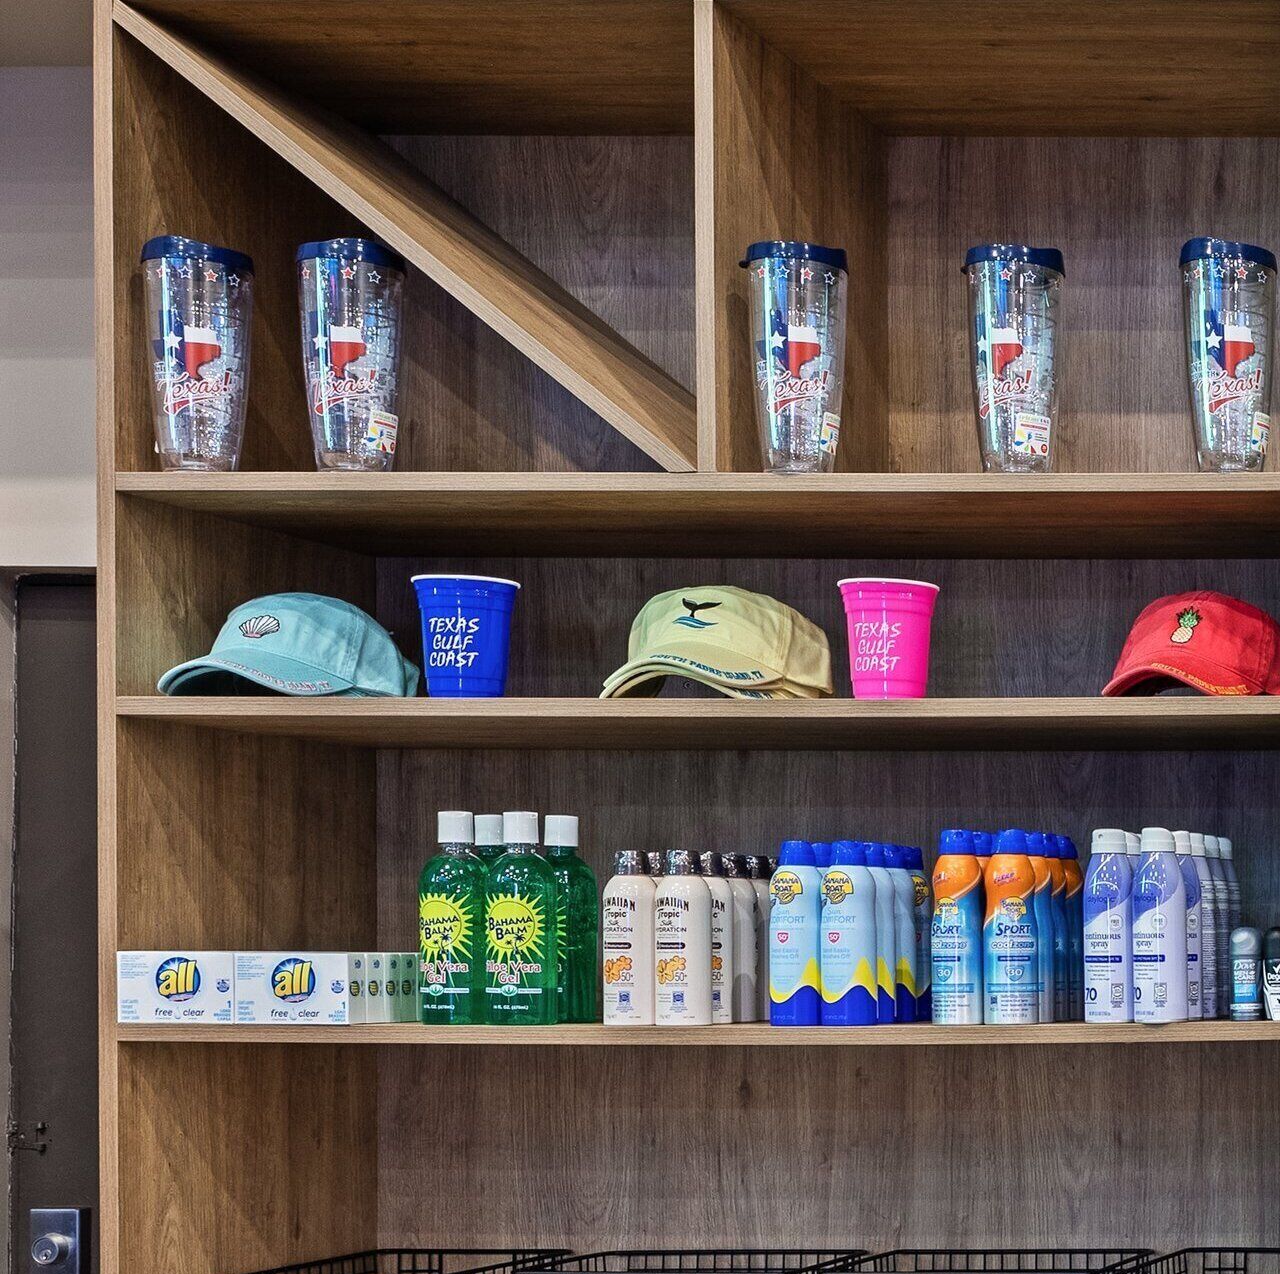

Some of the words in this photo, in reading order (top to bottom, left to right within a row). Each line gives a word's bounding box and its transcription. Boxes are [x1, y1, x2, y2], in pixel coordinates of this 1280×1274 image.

[157, 370, 232, 416] Texas!
[428, 616, 481, 634] TEXAS
[854, 621, 902, 637] TEXAS
[432, 634, 474, 650] GULF
[857, 639, 896, 655] GULF
[429, 651, 480, 668] COAST
[854, 655, 902, 672] COAST
[771, 874, 798, 885] BANANA
[823, 873, 850, 885] BANANA
[773, 884, 793, 893] BOAT
[824, 884, 844, 893] BOAT
[605, 908, 628, 918] Tropic
[657, 908, 681, 919] Tropic
[488, 915, 534, 931] BAHAMA
[932, 923, 960, 936] SPORT
[995, 922, 1031, 936] SPORT
[425, 925, 454, 940] BALM
[495, 926, 528, 941] BALM
[1090, 940, 1109, 949] spray
[1136, 940, 1152, 949] spray
[438, 960, 469, 973] Vera
[509, 961, 542, 973] Vera
[1006, 968, 1022, 976] 30
[1233, 961, 1256, 970] Dove
[158, 959, 198, 997] all
[274, 960, 313, 998] all
[427, 971, 447, 984] Gel
[498, 971, 521, 984] Gel
[937, 968, 951, 977] 30
[154, 1007, 173, 1017] free
[182, 1007, 205, 1017] clear
[270, 1008, 289, 1018] free
[298, 1009, 320, 1018] clear
